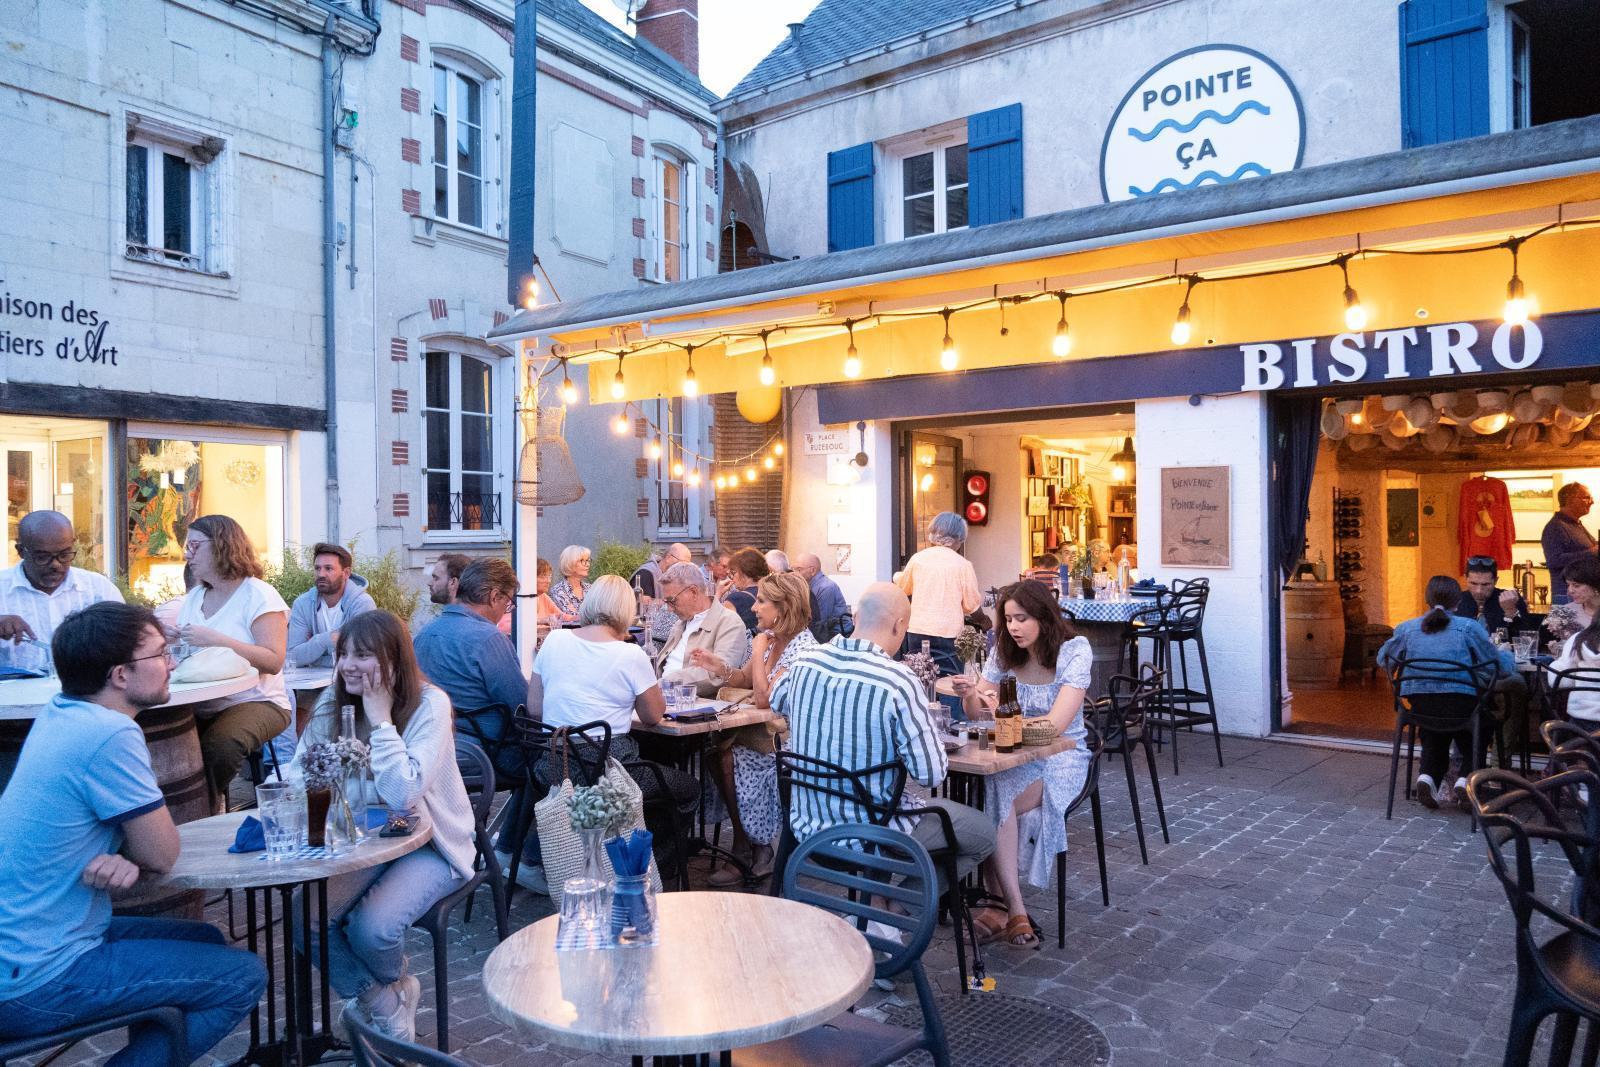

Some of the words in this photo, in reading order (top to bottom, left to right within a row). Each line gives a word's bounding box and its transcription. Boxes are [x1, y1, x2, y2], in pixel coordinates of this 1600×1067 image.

[1142, 66, 1252, 112] POINTE
[1175, 138, 1218, 170] ÇA
[61, 300, 99, 326] des
[56, 320, 118, 367] d'Art
[1240, 320, 1544, 391] BISTRO
[818, 433, 835, 441] PLACE
